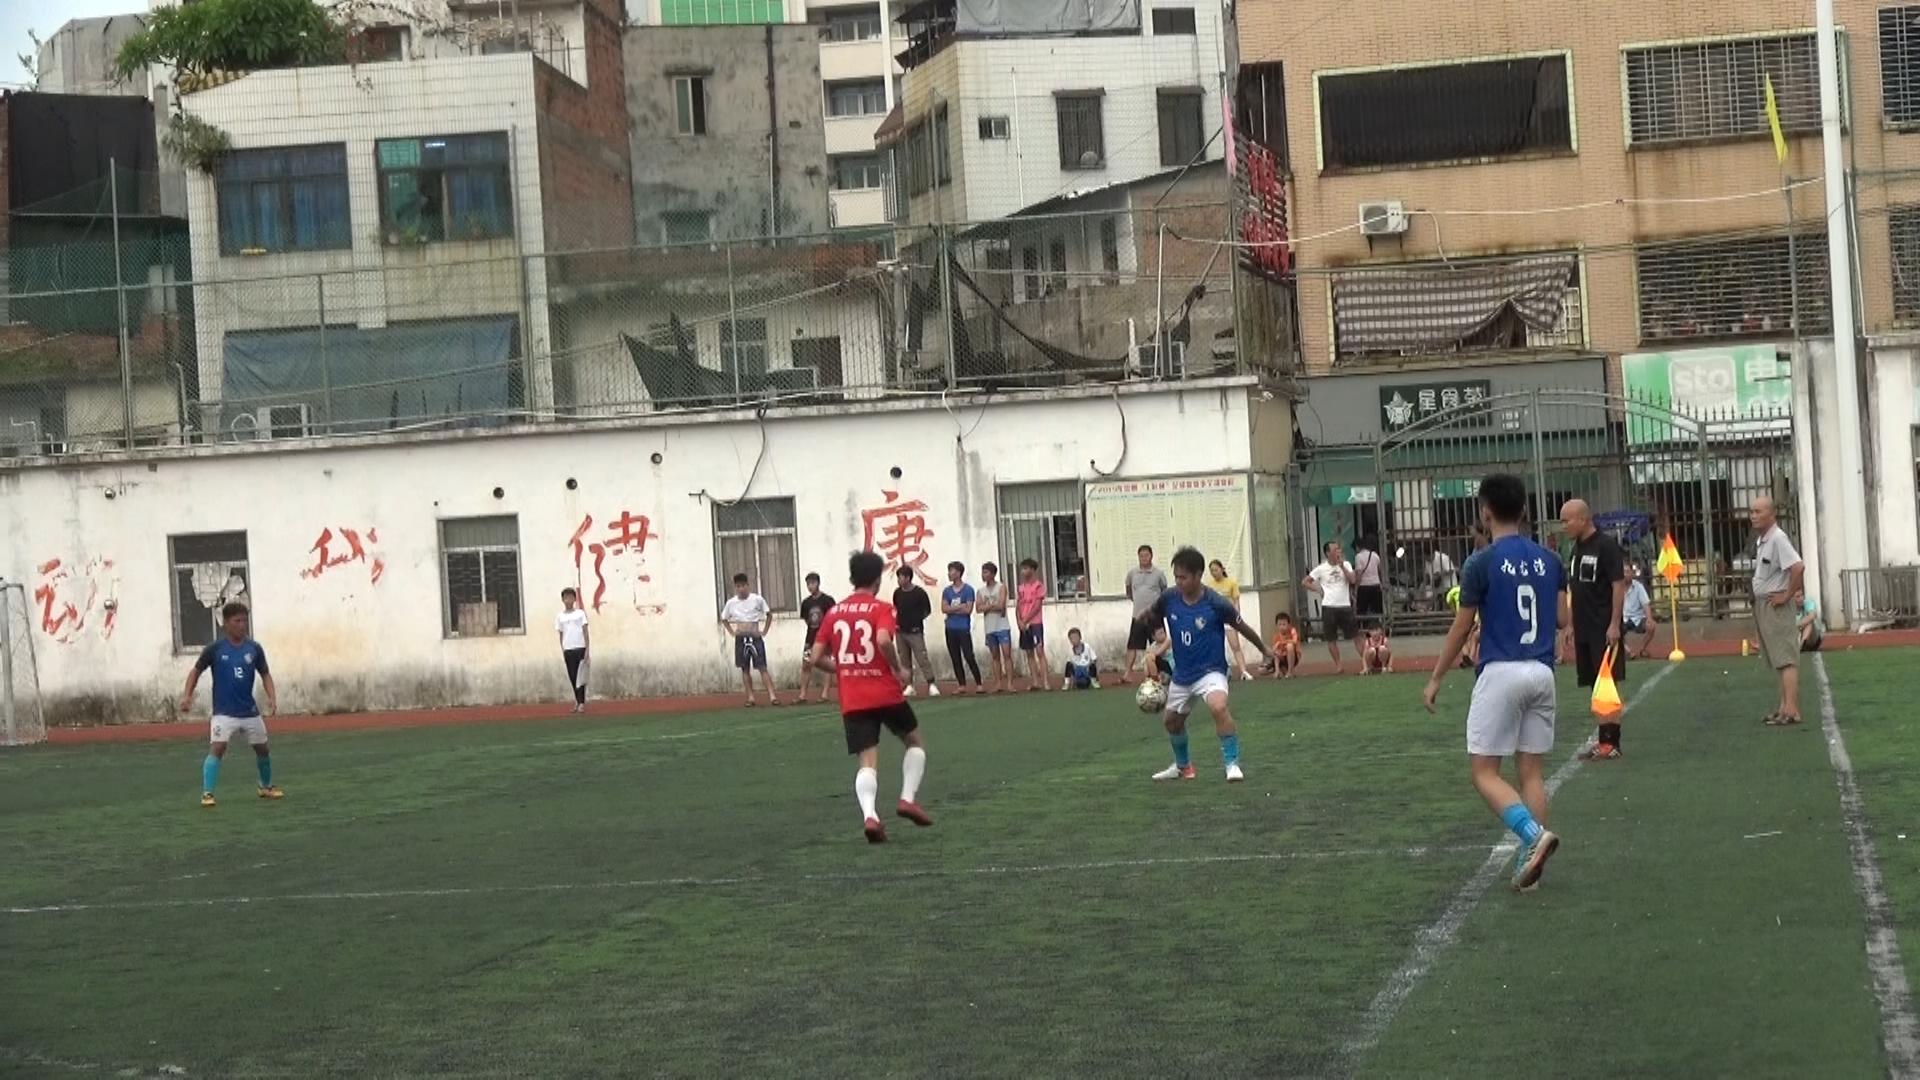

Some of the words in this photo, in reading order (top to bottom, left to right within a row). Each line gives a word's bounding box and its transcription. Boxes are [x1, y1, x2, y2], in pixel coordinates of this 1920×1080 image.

[1516, 584, 1537, 645] 9
[832, 618, 876, 665] 23
[1180, 630, 1192, 647] 10
[233, 666, 244, 679] 12
